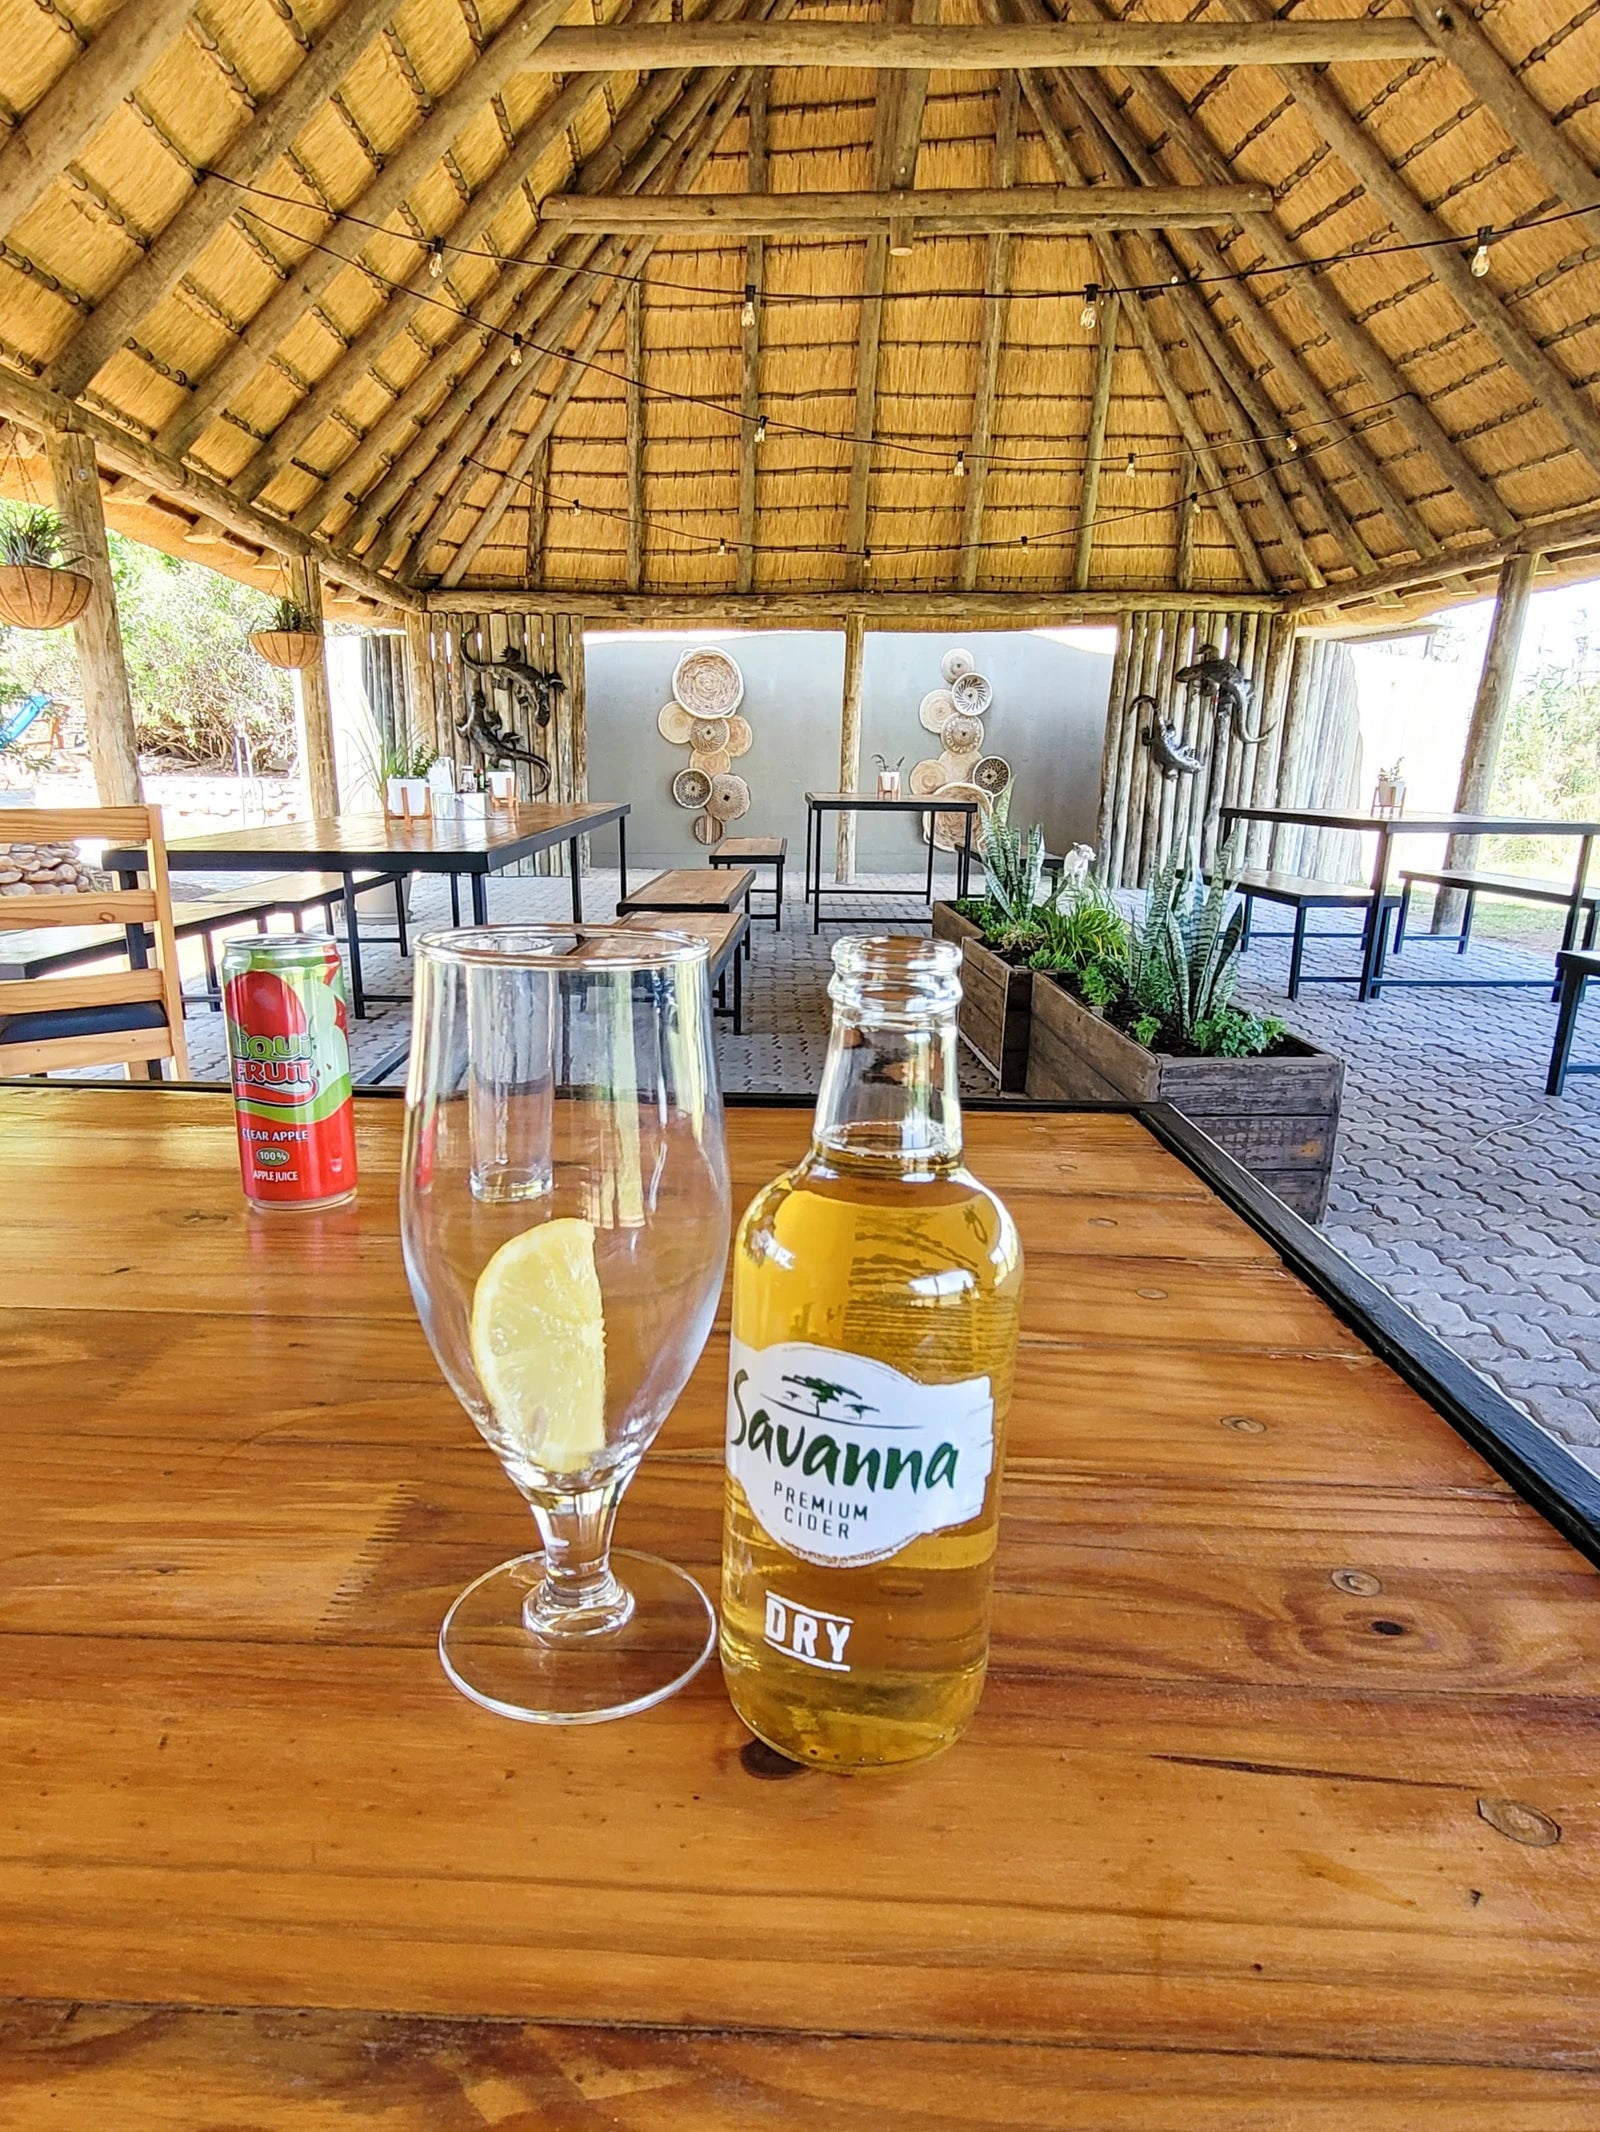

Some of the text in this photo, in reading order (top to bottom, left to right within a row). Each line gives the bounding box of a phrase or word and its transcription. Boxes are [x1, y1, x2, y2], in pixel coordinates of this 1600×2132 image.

[242, 1127, 309, 1142] CLEAR APPLE
[259, 1151, 287, 1161] 100%
[253, 1170, 299, 1183] APPLE JUICE
[731, 1369, 960, 1494] Savanna
[773, 1480, 869, 1522] PREMIUM
[784, 1508, 850, 1541] CIDER
[763, 1603, 851, 1663] DRY
